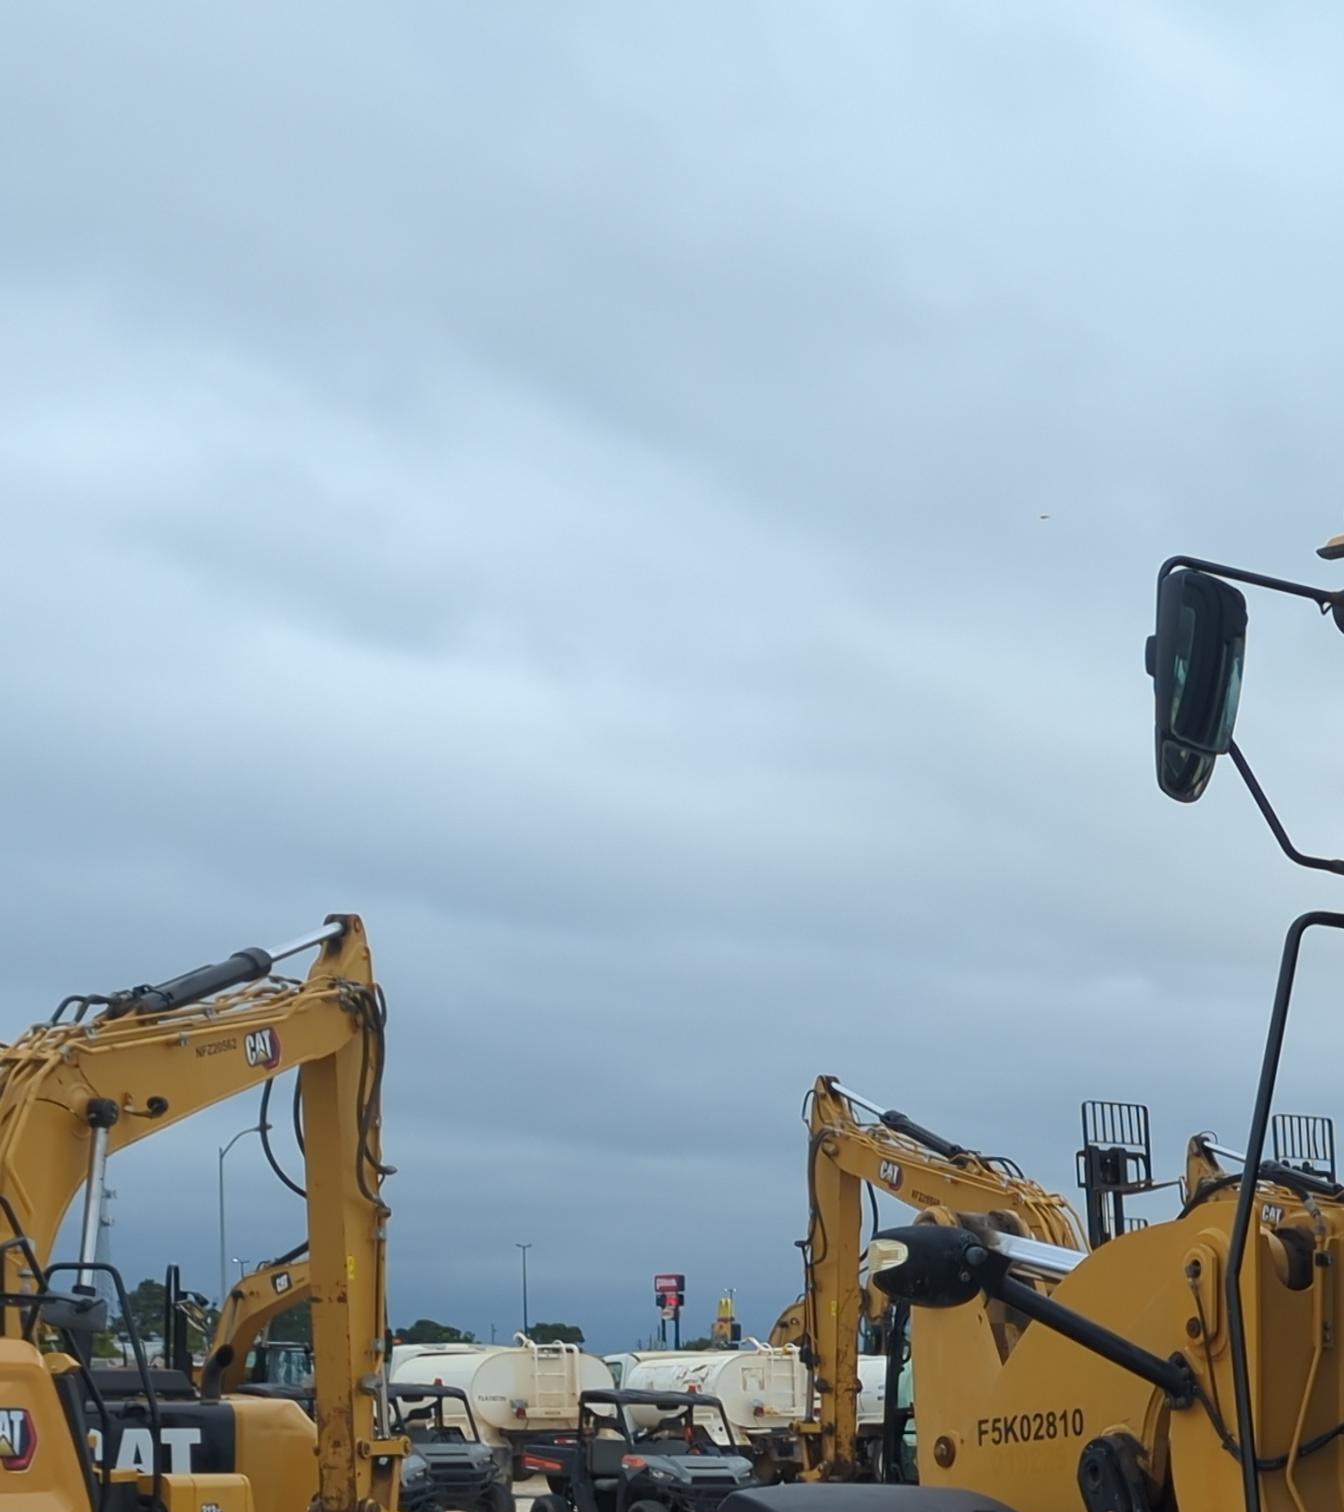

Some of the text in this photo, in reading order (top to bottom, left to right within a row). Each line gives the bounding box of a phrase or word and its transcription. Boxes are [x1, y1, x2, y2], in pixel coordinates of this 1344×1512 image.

[245, 1028, 273, 1067] CAT
[880, 1160, 900, 1185] CAT
[1262, 1204, 1282, 1224] CAT
[0, 1410, 24, 1457] AT
[977, 1407, 1085, 1447] F5K02810
